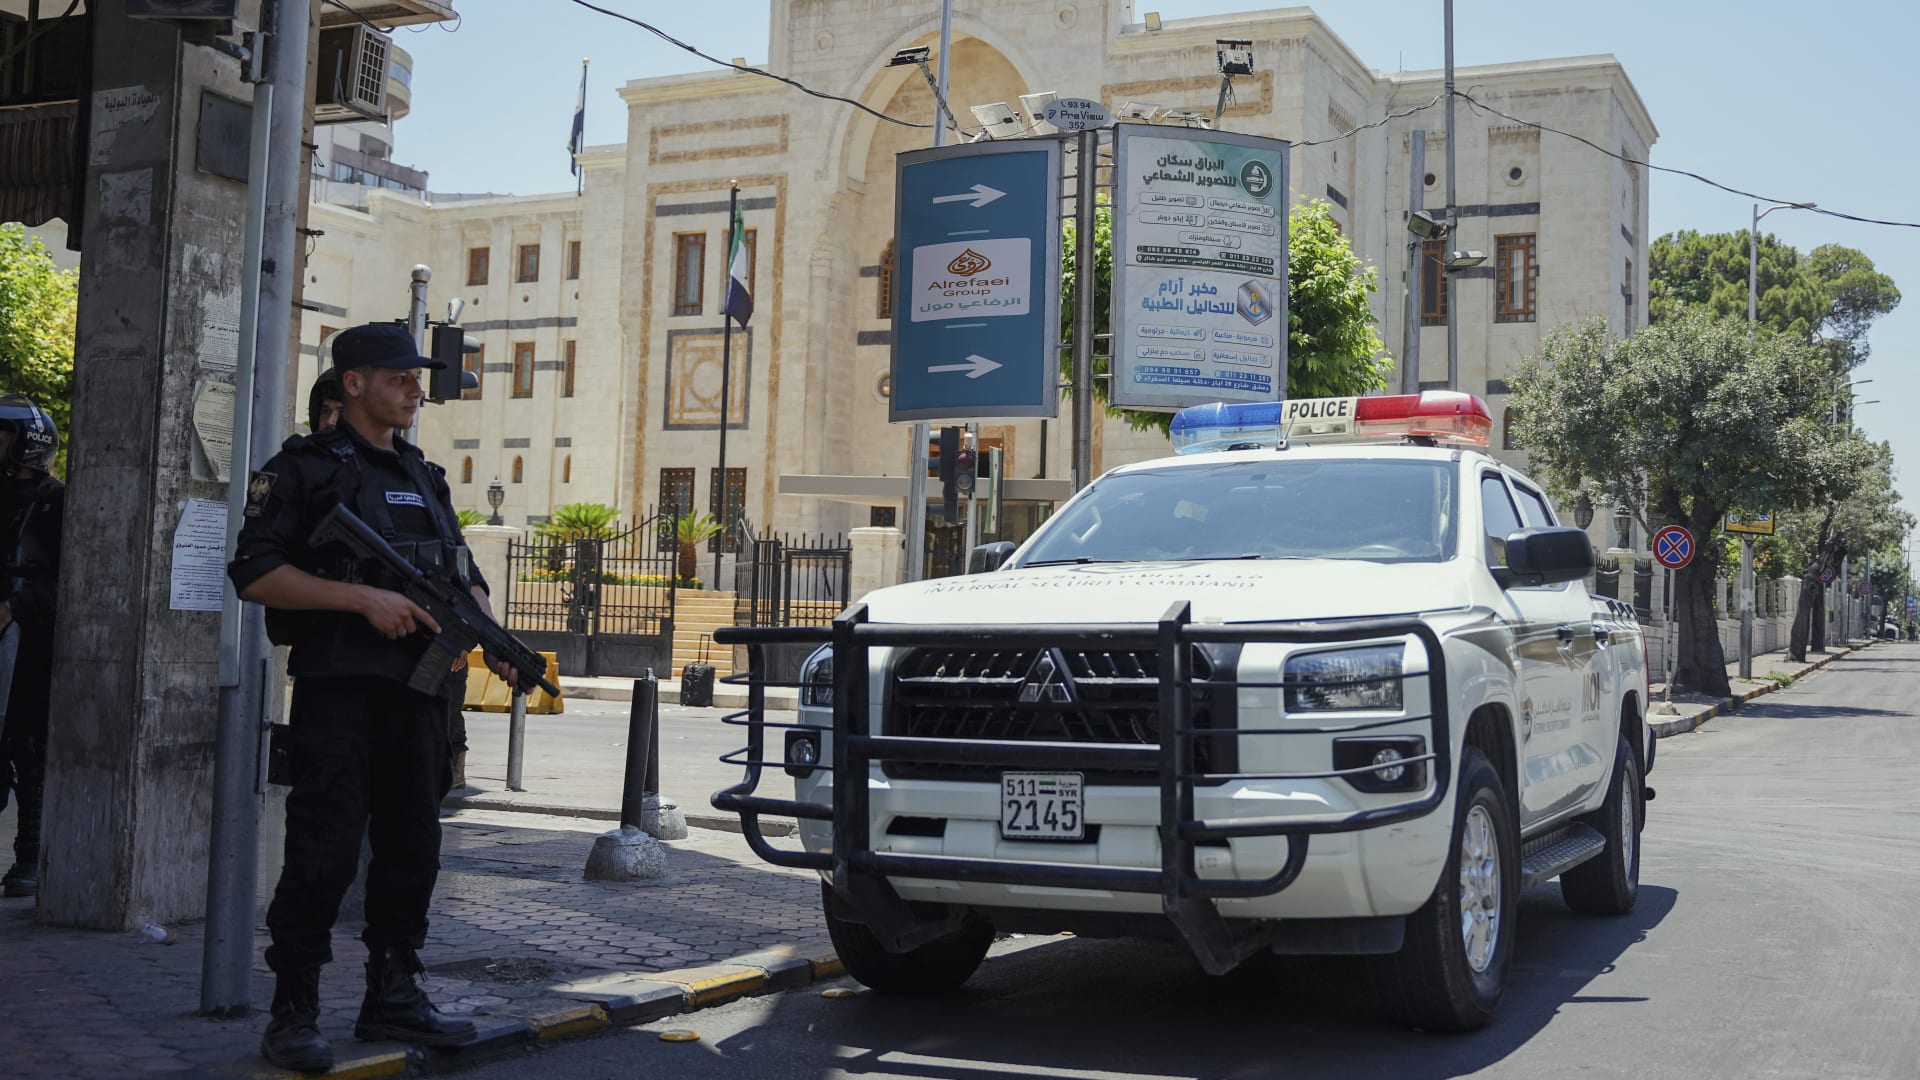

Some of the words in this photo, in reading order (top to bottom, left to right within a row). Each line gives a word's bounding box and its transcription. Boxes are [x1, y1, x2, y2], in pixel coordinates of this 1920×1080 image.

[1060, 110, 1104, 120] PreView
[1157, 154, 1192, 168] سكان
[1194, 158, 1224, 172] البراق
[1142, 170, 1194, 185] الشعاعي
[1196, 176, 1236, 187] للتصوير
[928, 277, 1009, 291] Alrefaei
[1159, 278, 1183, 296] آرام
[1189, 282, 1218, 296] مخبر
[920, 302, 953, 312] مول
[959, 298, 1022, 310] الرفاعي
[1142, 296, 1183, 312] الطبية
[1186, 299, 1234, 314] للتحاليل
[1289, 400, 1348, 418] POLICE
[26, 432, 53, 444] POLICE
[924, 582, 1019, 594] INTERNAL
[1032, 580, 1124, 589] SECURITY
[1135, 580, 1255, 588] COMMAND
[1007, 780, 1036, 796] 511
[1058, 789, 1077, 797] SYR
[1007, 800, 1077, 832] 2145
